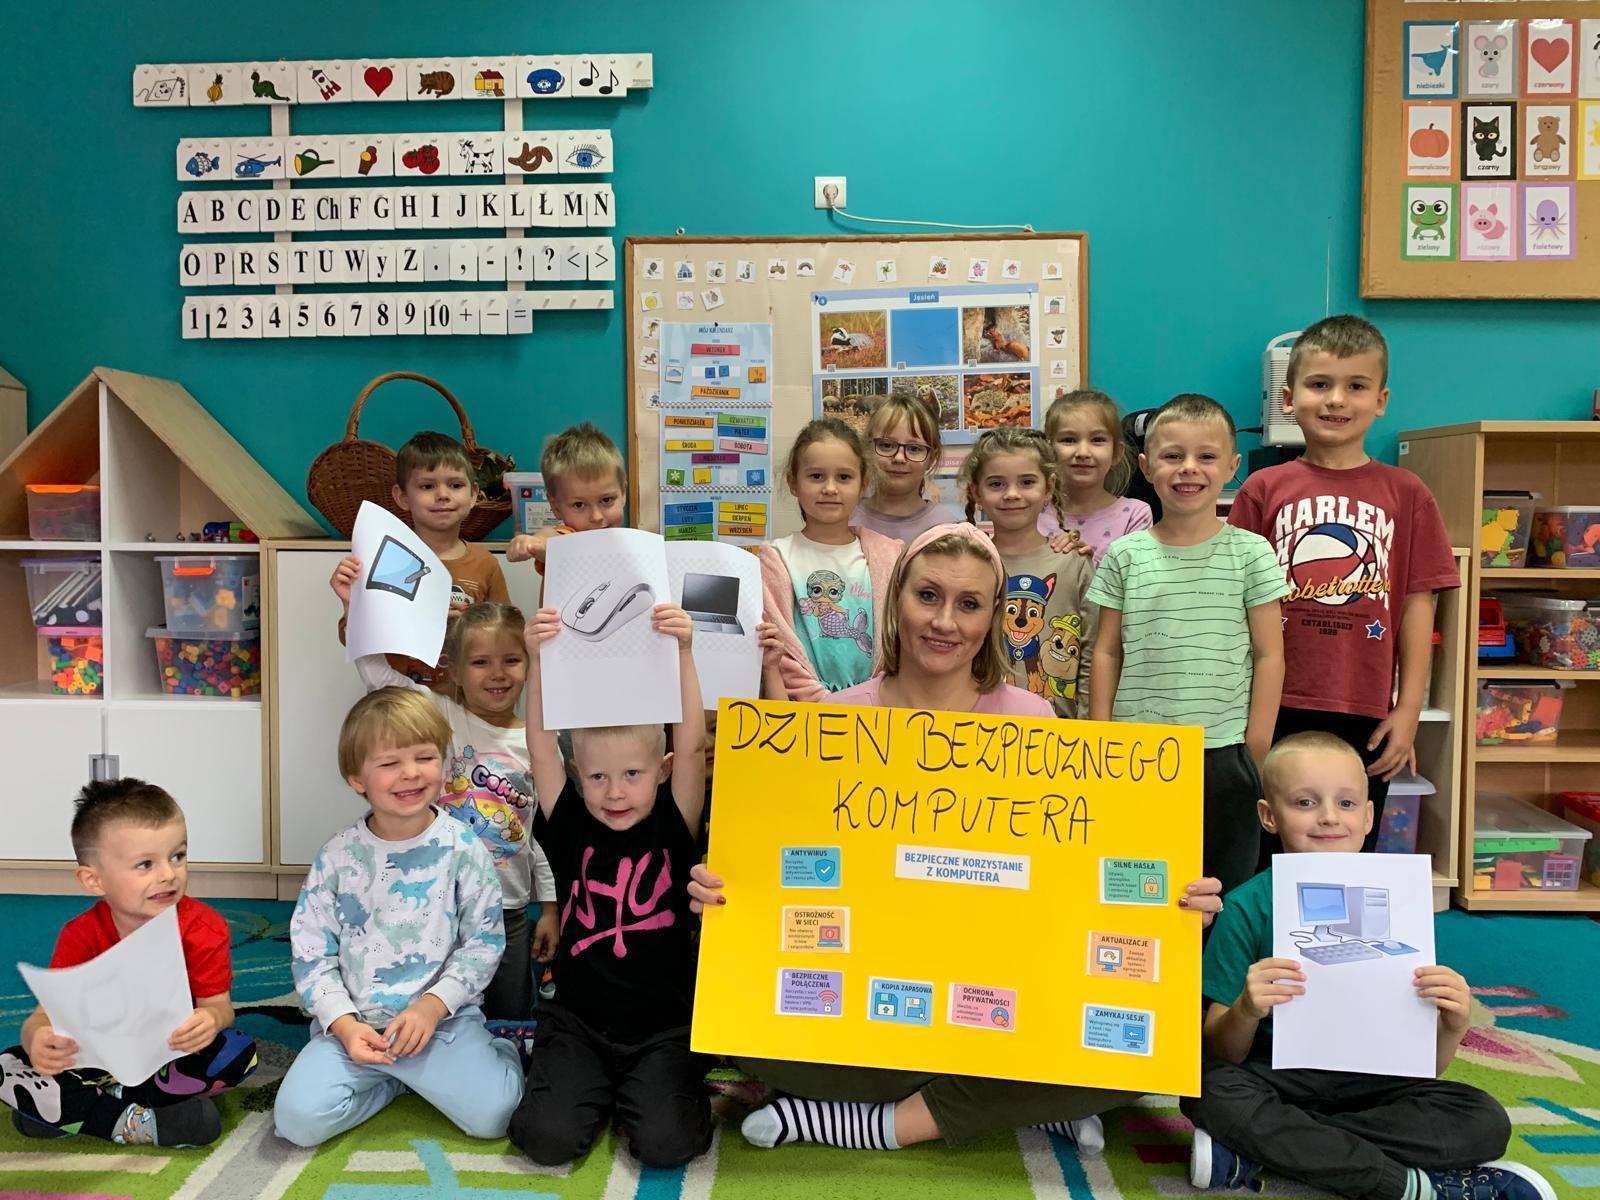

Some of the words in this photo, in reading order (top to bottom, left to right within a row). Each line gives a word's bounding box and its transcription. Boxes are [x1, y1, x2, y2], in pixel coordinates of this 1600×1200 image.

[1477, 164, 1499, 172] czarny
[183, 200, 198, 223] A
[212, 199, 225, 221] B
[237, 199, 252, 220] C
[267, 199, 280, 220] D
[291, 198, 305, 220] E
[316, 197, 339, 220] Ch
[350, 197, 361, 219] F
[374, 197, 389, 219] G
[401, 195, 417, 218] H
[431, 195, 440, 218] I
[456, 195, 466, 217] J
[482, 194, 498, 217] K
[511, 193, 525, 217] L
[539, 193, 553, 216] Ł
[564, 193, 583, 216] M
[594, 193, 609, 216] N
[184, 252, 200, 276] O
[215, 252, 226, 274] P
[240, 252, 255, 274] R
[268, 251, 280, 273] S
[294, 251, 308, 273] T
[318, 250, 333, 273] U
[345, 249, 365, 272] W
[403, 249, 418, 271] Z
[517, 248, 522, 271] !
[545, 248, 555, 271] ?
[190, 307, 198, 330] 1
[216, 306, 227, 329] 2
[241, 306, 254, 329] 3
[269, 306, 281, 328] 4
[297, 305, 309, 327] 5
[324, 305, 336, 327] 6
[350, 304, 362, 326] 7
[377, 303, 389, 326] 8
[405, 302, 416, 325] 9
[428, 304, 450, 327] 10
[1275, 495, 1395, 549] HARLEM
[728, 701, 892, 766] DZIEŃ
[906, 711, 1180, 783] BEZPIECZNEGO
[833, 779, 1096, 844] KOMPUTERA
[790, 849, 828, 857] ANTYWIRUS
[904, 852, 960, 867] BEZPIECZNE
[962, 857, 1024, 872] KORZYSTANIE
[1113, 861, 1132, 869] SILNE
[1133, 862, 1156, 870] HASŁA
[926, 866, 933, 877] Z
[935, 867, 1000, 883] KOMPUTERA
[1101, 935, 1149, 948] AKTUALIZACJE
[791, 972, 829, 981] BEZPIECZNE
[791, 980, 831, 989] POŁĄCZENIA
[881, 983, 900, 991] KOPIA
[900, 984, 933, 994] ZAPASOWA
[963, 987, 994, 997] OCHRONA
[1095, 1009, 1125, 1020] ZAMYKAJ
